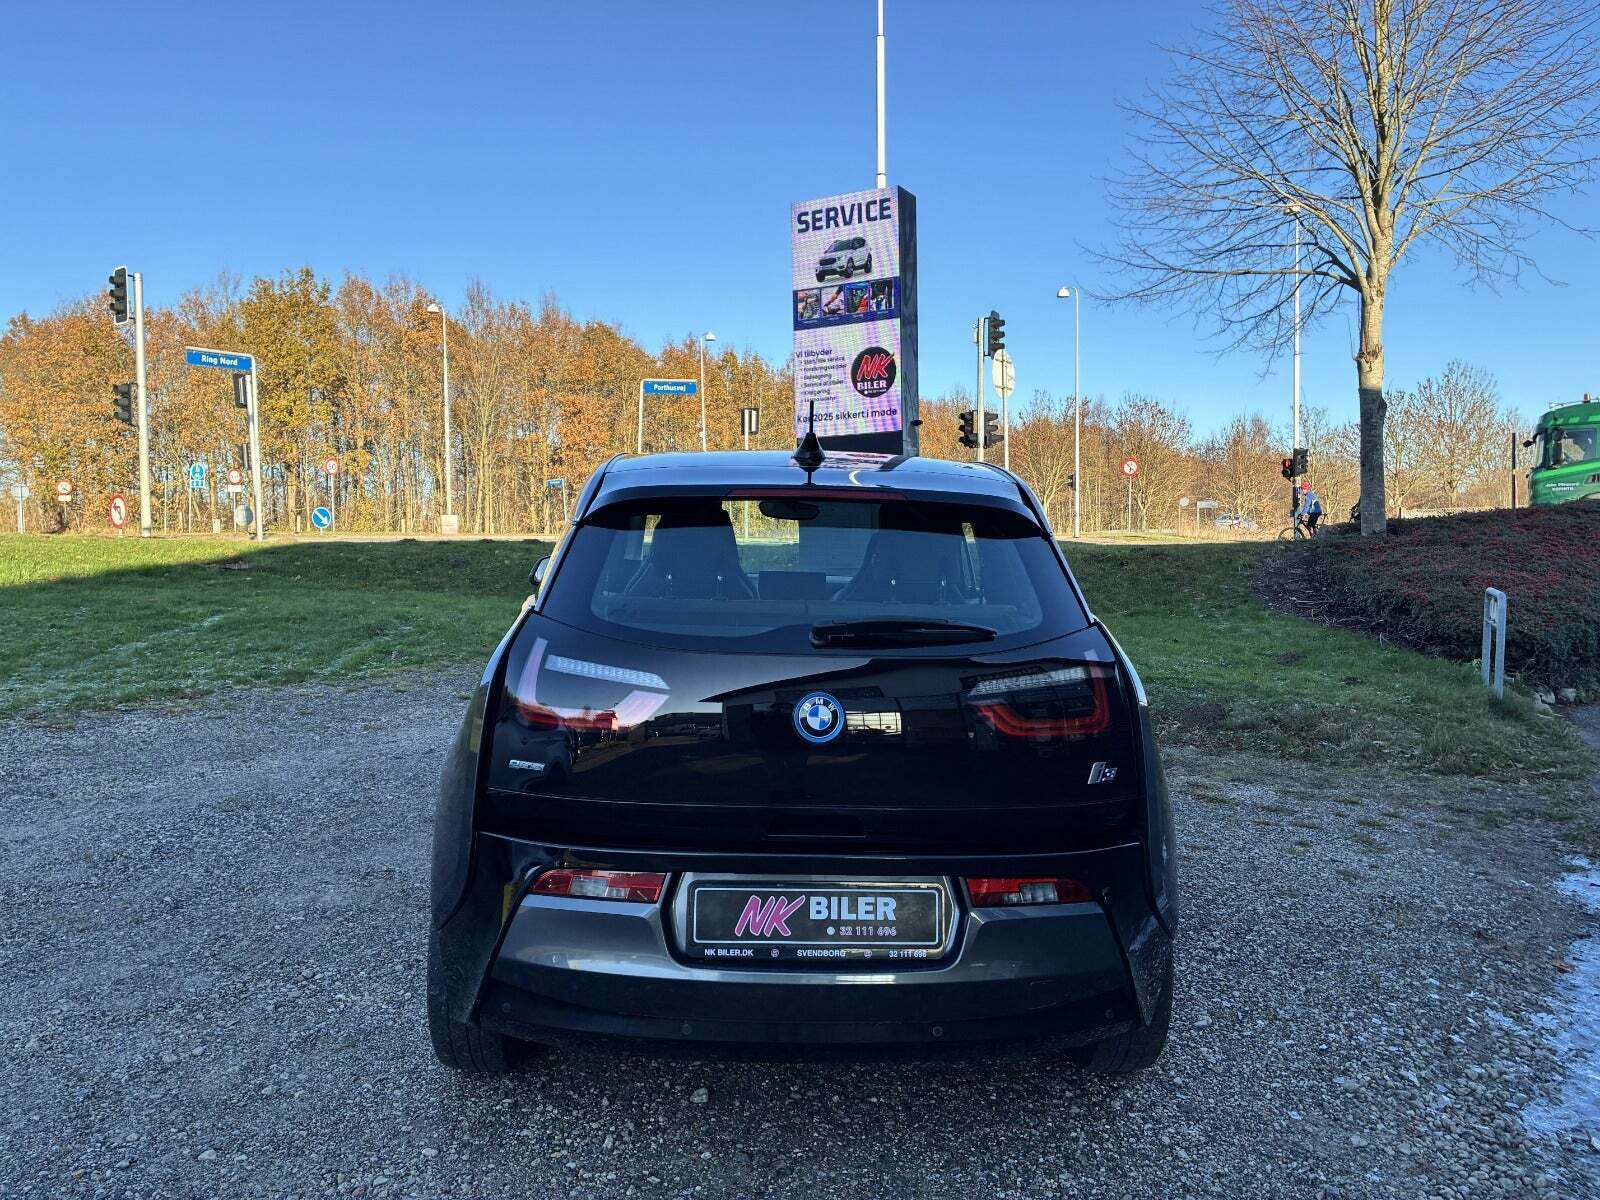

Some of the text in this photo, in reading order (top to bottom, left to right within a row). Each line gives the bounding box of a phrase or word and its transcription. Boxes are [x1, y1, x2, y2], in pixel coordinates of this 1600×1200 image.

[797, 197, 892, 233] SERVICE
[201, 355, 238, 366] Ring Nord
[857, 353, 895, 380] NK
[857, 380, 887, 390] BILER
[797, 415, 813, 423] Kø
[813, 412, 834, 421] 2025
[835, 408, 865, 420] sikkert
[871, 407, 898, 417] møde
[735, 895, 897, 937] NK BILER
[839, 926, 897, 936] 32 111 696
[717, 949, 754, 957] BILER.DK
[797, 949, 846, 957] SVENDBORG
[889, 950, 898, 958] 32
[900, 950, 912, 958] 111
